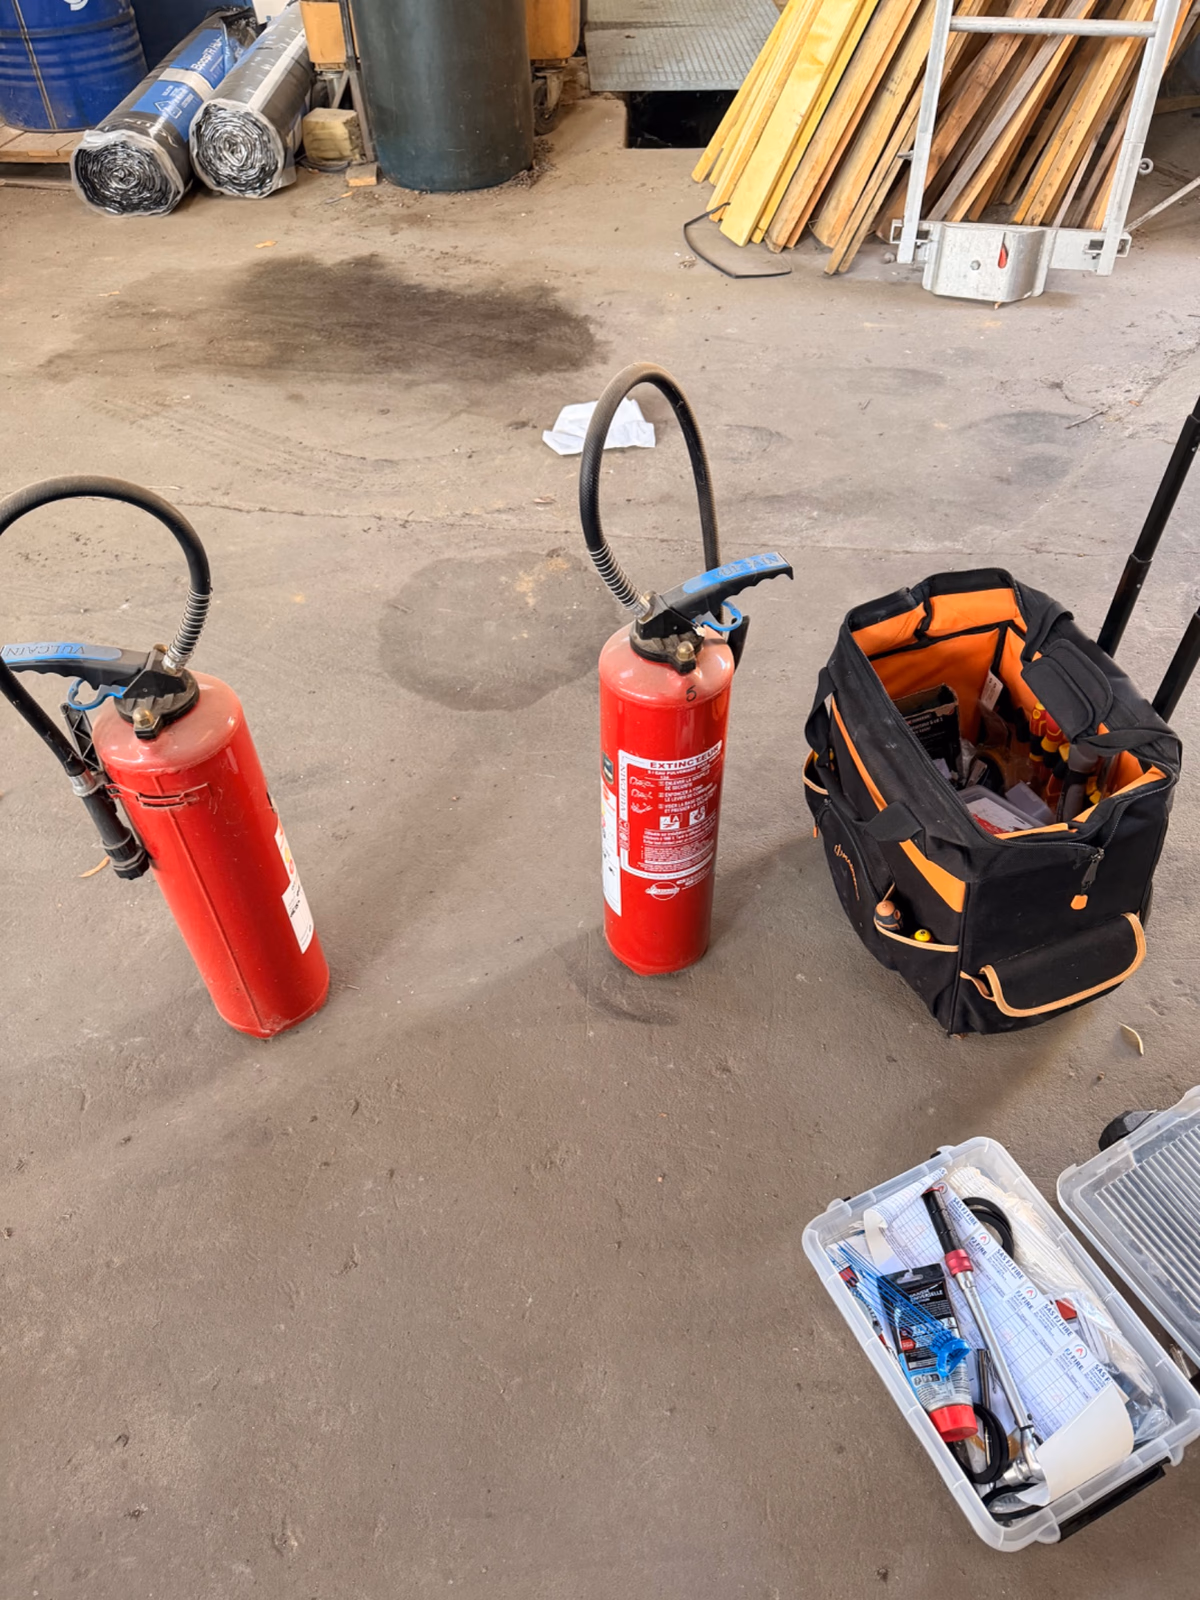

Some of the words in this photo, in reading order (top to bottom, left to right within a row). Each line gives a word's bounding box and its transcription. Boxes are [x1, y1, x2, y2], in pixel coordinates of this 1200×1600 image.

[711, 554, 779, 579] VULCAIN
[5, 645, 87, 656] VULCAIN
[650, 745, 720, 769] EXTINCTEUR
[953, 1197, 963, 1208] SAS
[966, 1211, 978, 1226] FIRE
[976, 1243, 988, 1256] FIRE
[996, 1248, 1007, 1261] SAS
[1005, 1258, 1014, 1268] FJ
[1011, 1266, 1025, 1280] FIRE
[1021, 1298, 1034, 1311] FIRE
[1043, 1303, 1055, 1317] SAS
[1053, 1315, 1062, 1325] FJ
[1059, 1322, 1074, 1338] FIRE
[1064, 1348, 1072, 1357] FJ
[1070, 1355, 1085, 1371] FIRE
[1094, 1363, 1106, 1379] SAS
